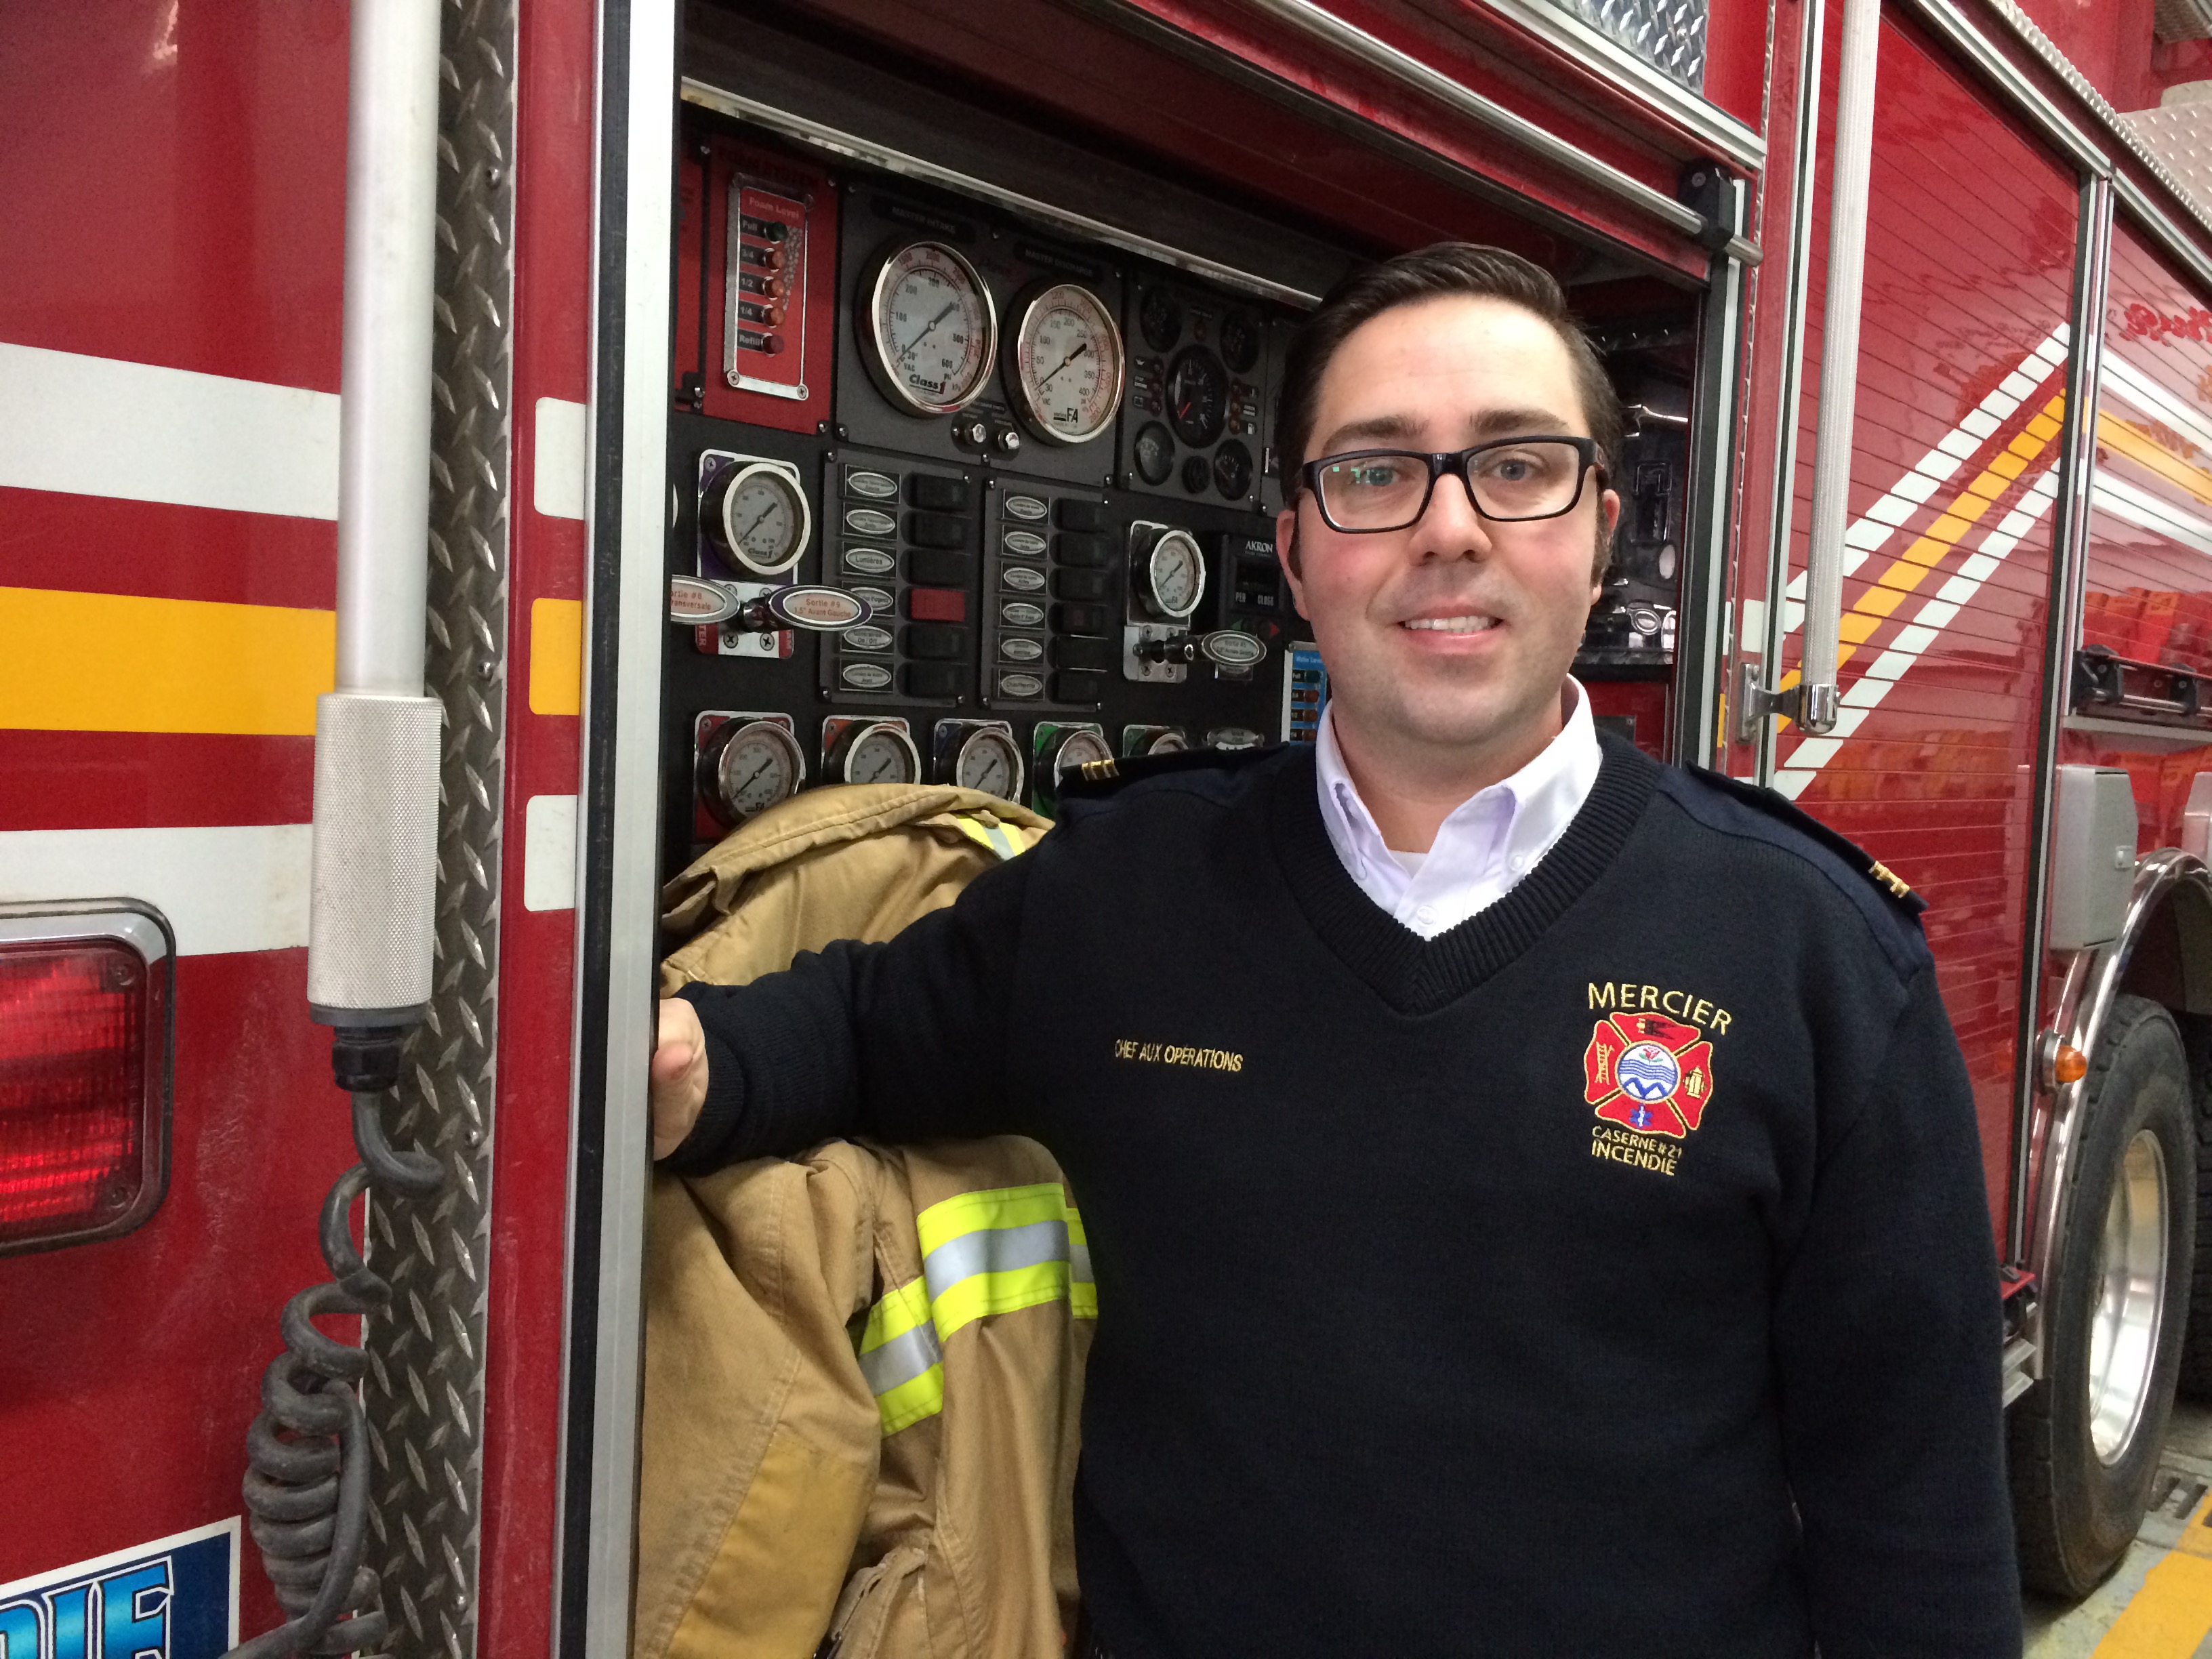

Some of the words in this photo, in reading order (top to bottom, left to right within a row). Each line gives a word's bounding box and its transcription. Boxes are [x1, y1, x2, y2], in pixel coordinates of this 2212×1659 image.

[749, 197, 774, 211] Foam
[775, 203, 799, 218] Level
[905, 284, 917, 295] 200
[895, 311, 907, 322] 100
[1063, 318, 1075, 327] 200
[952, 333, 964, 344] 500
[941, 358, 953, 370] 600
[1036, 356, 1044, 365] 50
[1045, 384, 1052, 392] 30
[1078, 387, 1089, 397] 400
[1066, 407, 1079, 424] FA
[1245, 540, 1273, 554] AKRON
[855, 555, 883, 565] Lumières
[671, 590, 689, 598] ortie
[671, 599, 712, 611] ransversale
[806, 598, 827, 608] Sortie
[830, 600, 841, 609] #9
[808, 607, 826, 616] Avant
[827, 609, 852, 618] Gauche
[1588, 982, 1732, 1036] MERCIER
[1115, 1039, 1139, 1059] CHEF
[1139, 1042, 1163, 1062] AUX
[1592, 1125, 1658, 1150] CASERNE
[1591, 1139, 1677, 1176] INCENDIE
